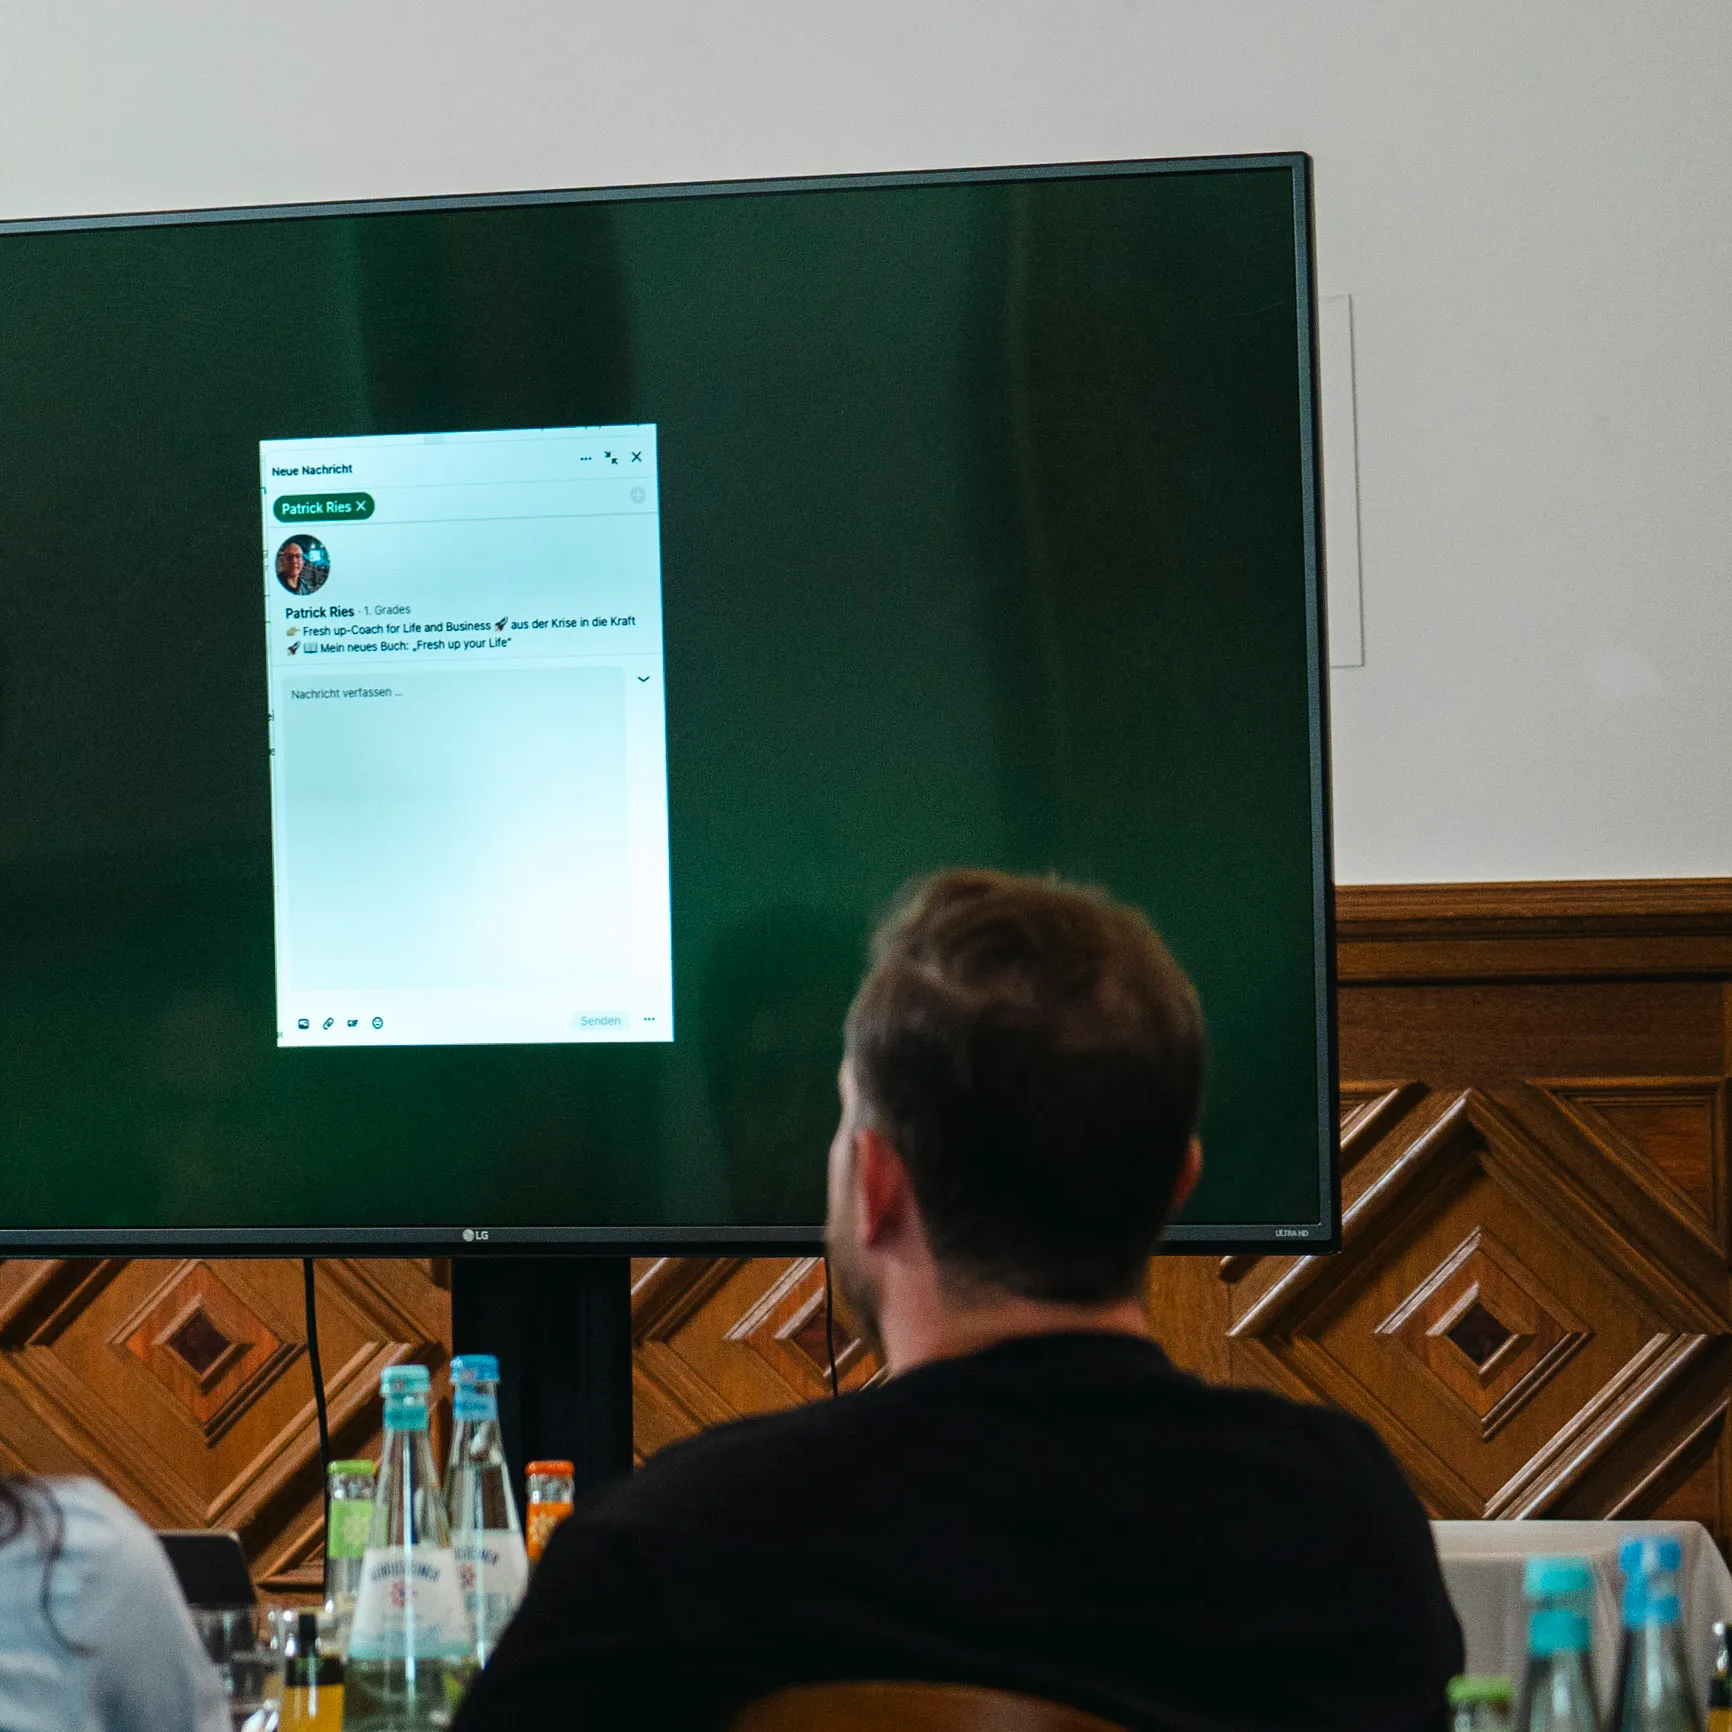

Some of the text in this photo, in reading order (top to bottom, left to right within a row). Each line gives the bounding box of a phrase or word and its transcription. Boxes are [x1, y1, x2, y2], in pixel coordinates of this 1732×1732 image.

[272, 464, 353, 476] Neue Nachricht
[282, 500, 352, 515] Patrick Ries
[285, 606, 326, 619] Patrick
[329, 605, 355, 617] Ries
[374, 605, 411, 616] Grades
[303, 615, 636, 637] Fresh up-Coach for Life and Business aus der Krise in die Kraft
[320, 642, 345, 653] Mein
[347, 643, 378, 652] neues
[381, 640, 409, 651] Buch:
[448, 641, 461, 651] up
[463, 639, 486, 650] your
[291, 688, 340, 699] Nachricht
[342, 687, 392, 698] verfassen
[580, 1016, 621, 1026] Senden
[476, 1231, 489, 1240] LG
